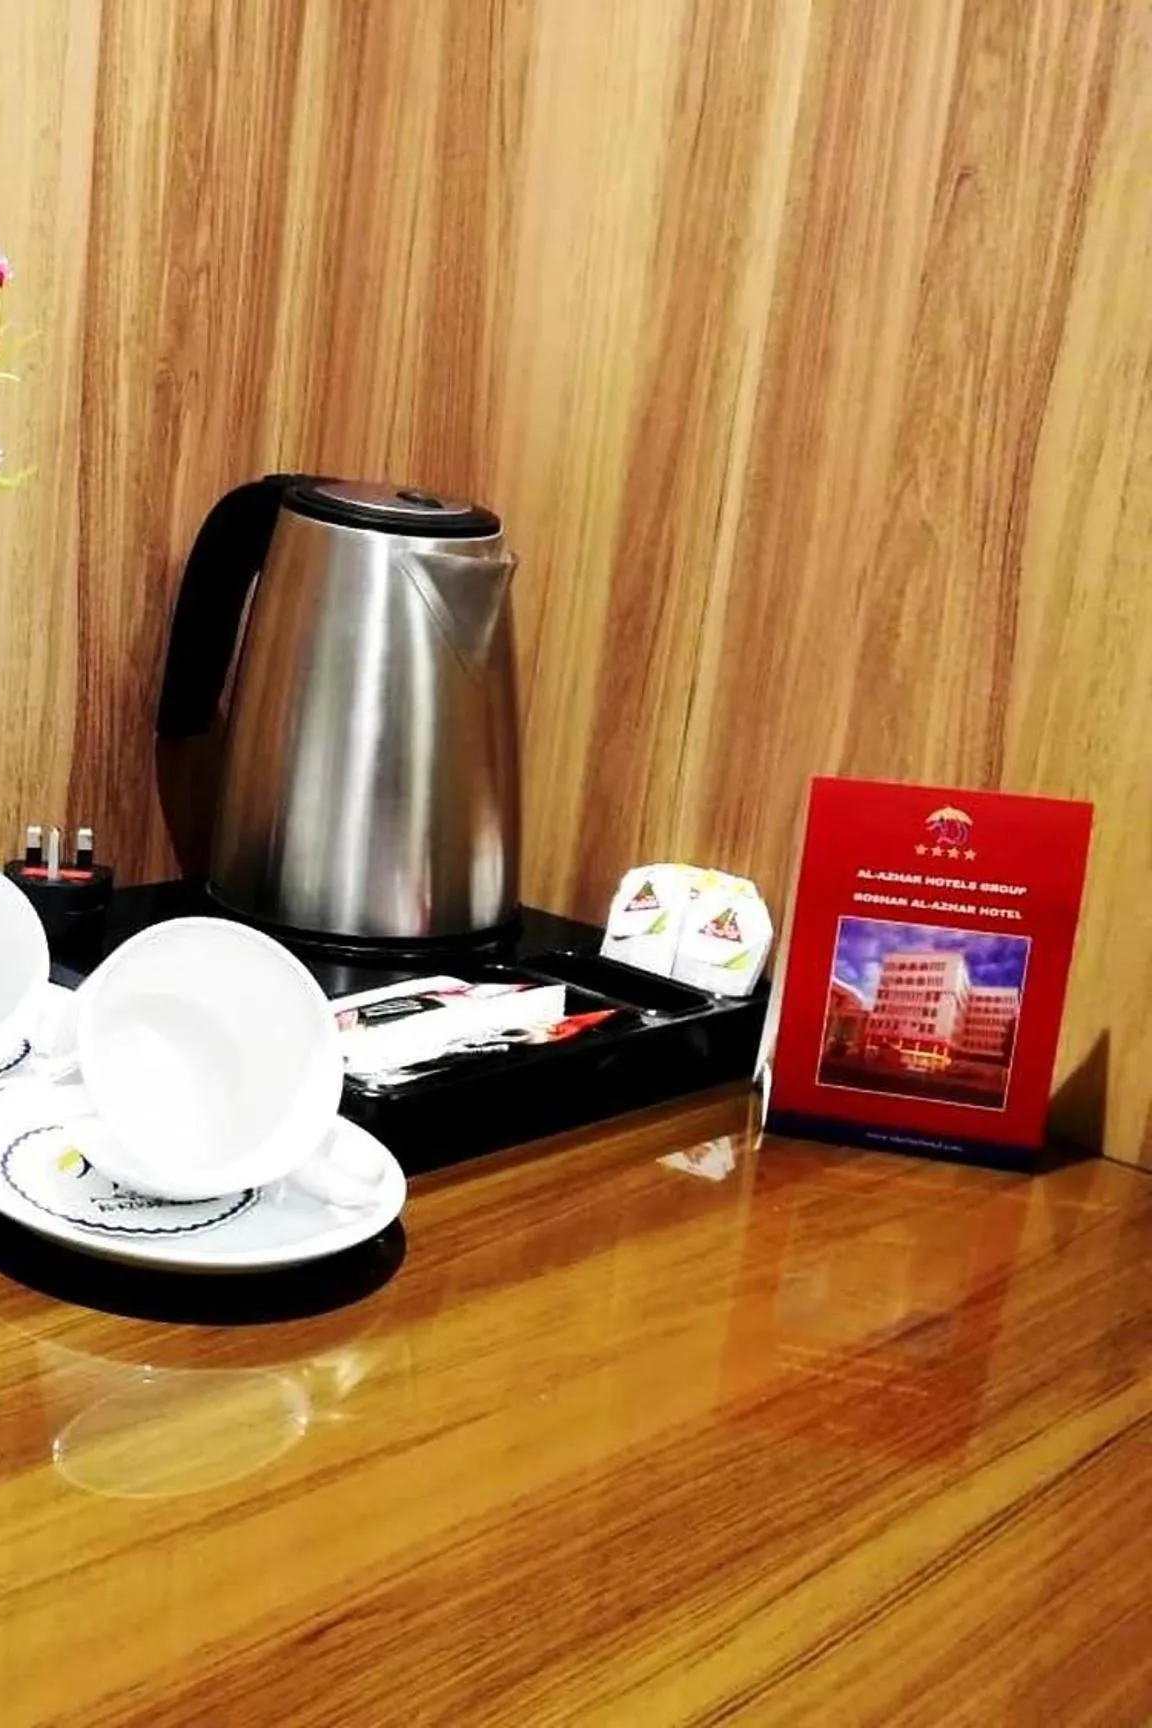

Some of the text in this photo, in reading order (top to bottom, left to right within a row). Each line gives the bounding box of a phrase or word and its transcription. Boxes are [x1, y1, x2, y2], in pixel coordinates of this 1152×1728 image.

[856, 869, 1027, 896] AL-AZHAR HOTELS GROUP
[910, 899, 977, 915] AL-AZHAR
[979, 906, 1023, 920] HOTEL
